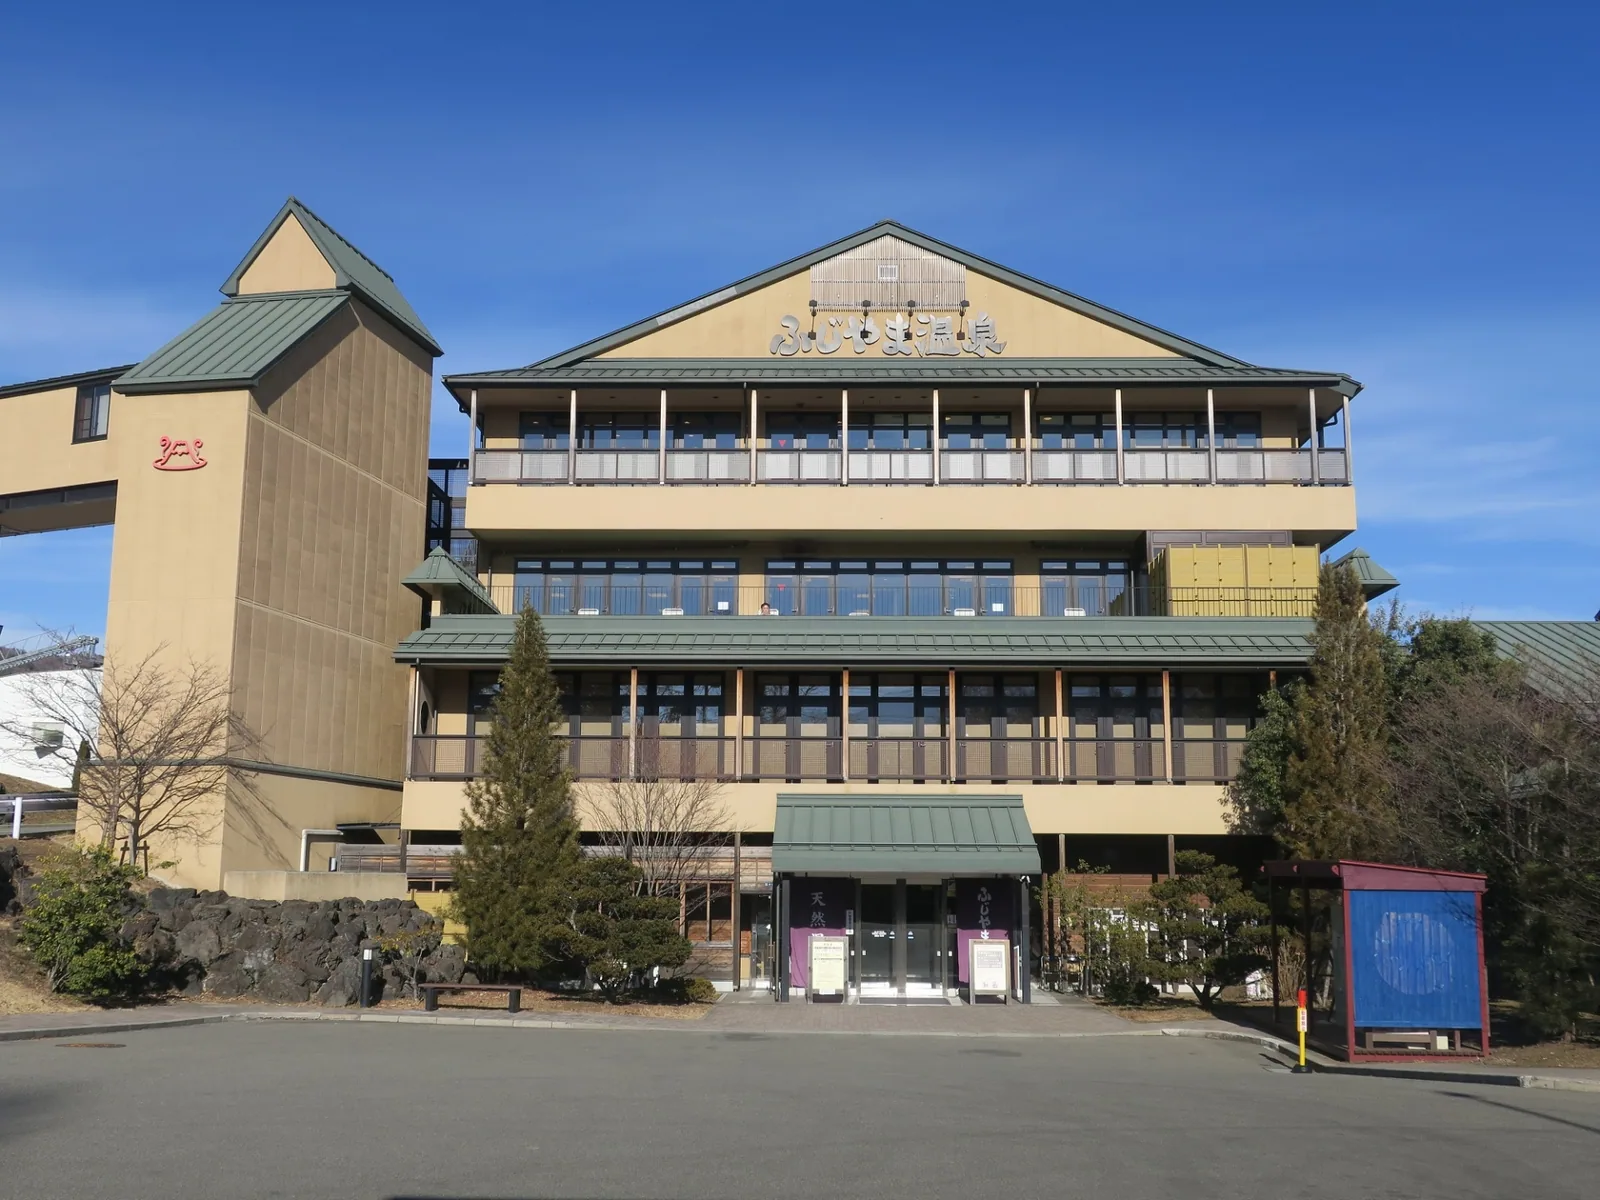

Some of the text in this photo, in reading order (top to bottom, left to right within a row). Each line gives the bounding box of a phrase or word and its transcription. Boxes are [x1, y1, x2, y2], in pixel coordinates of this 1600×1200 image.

[769, 312, 1007, 358] ふじやま温泉
